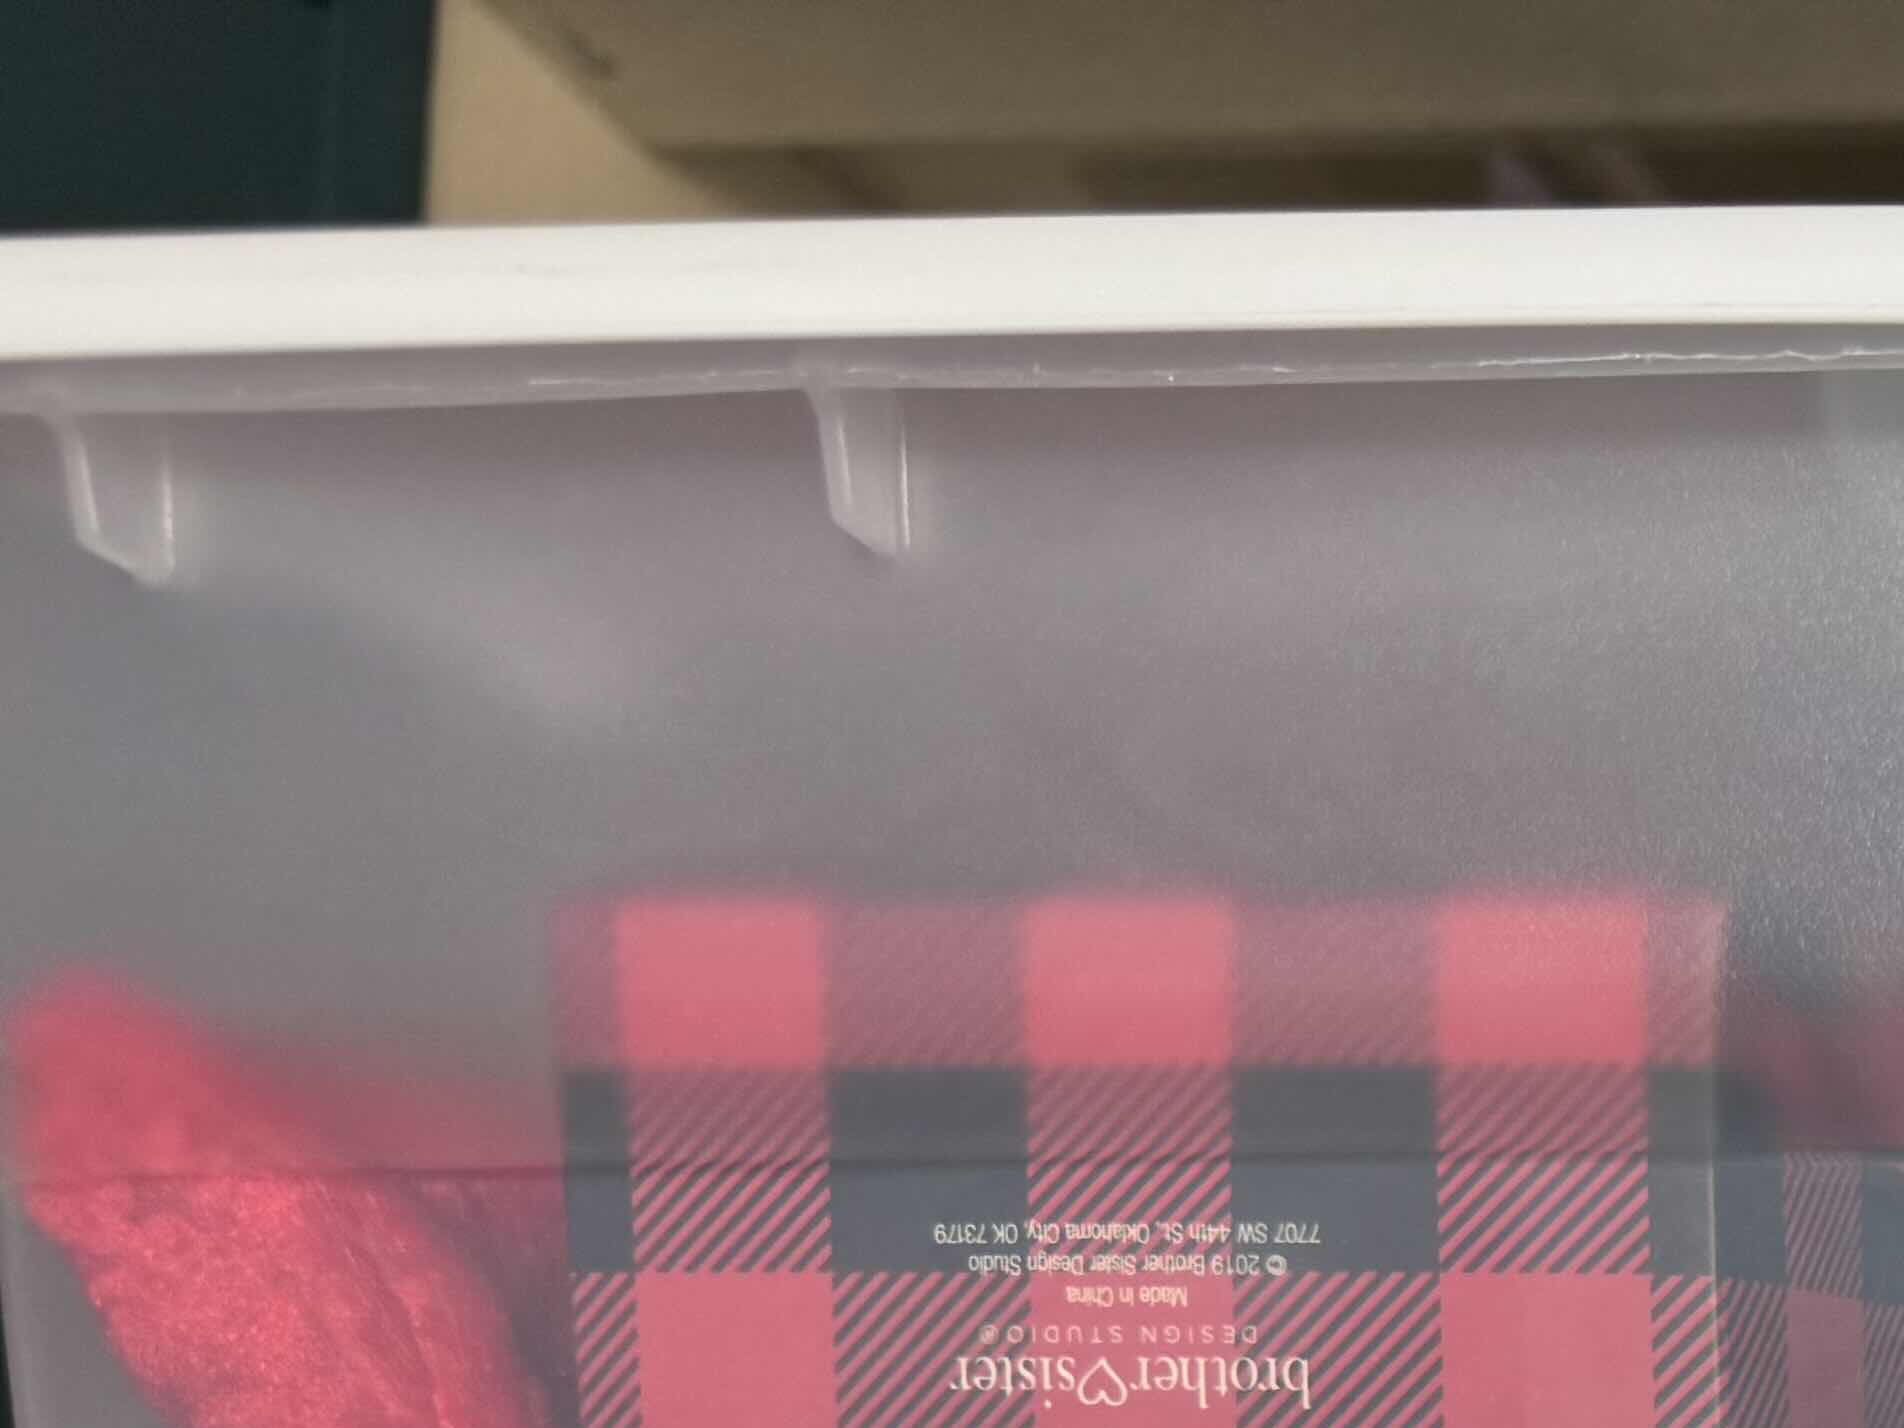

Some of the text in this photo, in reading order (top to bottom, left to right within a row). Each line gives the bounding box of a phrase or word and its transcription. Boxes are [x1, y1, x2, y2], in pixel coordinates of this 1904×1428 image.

[934, 1222, 988, 1245] 73179
[992, 1223, 1019, 1245] OK
[1065, 1222, 1151, 1244] Oklahoma
[1189, 1222, 1232, 1244] 44th
[1237, 1222, 1269, 1244] SW
[1274, 1222, 1321, 1244] 7707
[968, 1253, 1022, 1277] Studio
[1027, 1251, 1084, 1276] Design
[1089, 1254, 1137, 1276] Sister
[1143, 1254, 1206, 1277] Brother
[1211, 1254, 1261, 1276] 2019
[1065, 1285, 1188, 1307] Made in China
[1141, 1325, 1258, 1345] DESIGN
[949, 1356, 1312, 1410] brother sister
